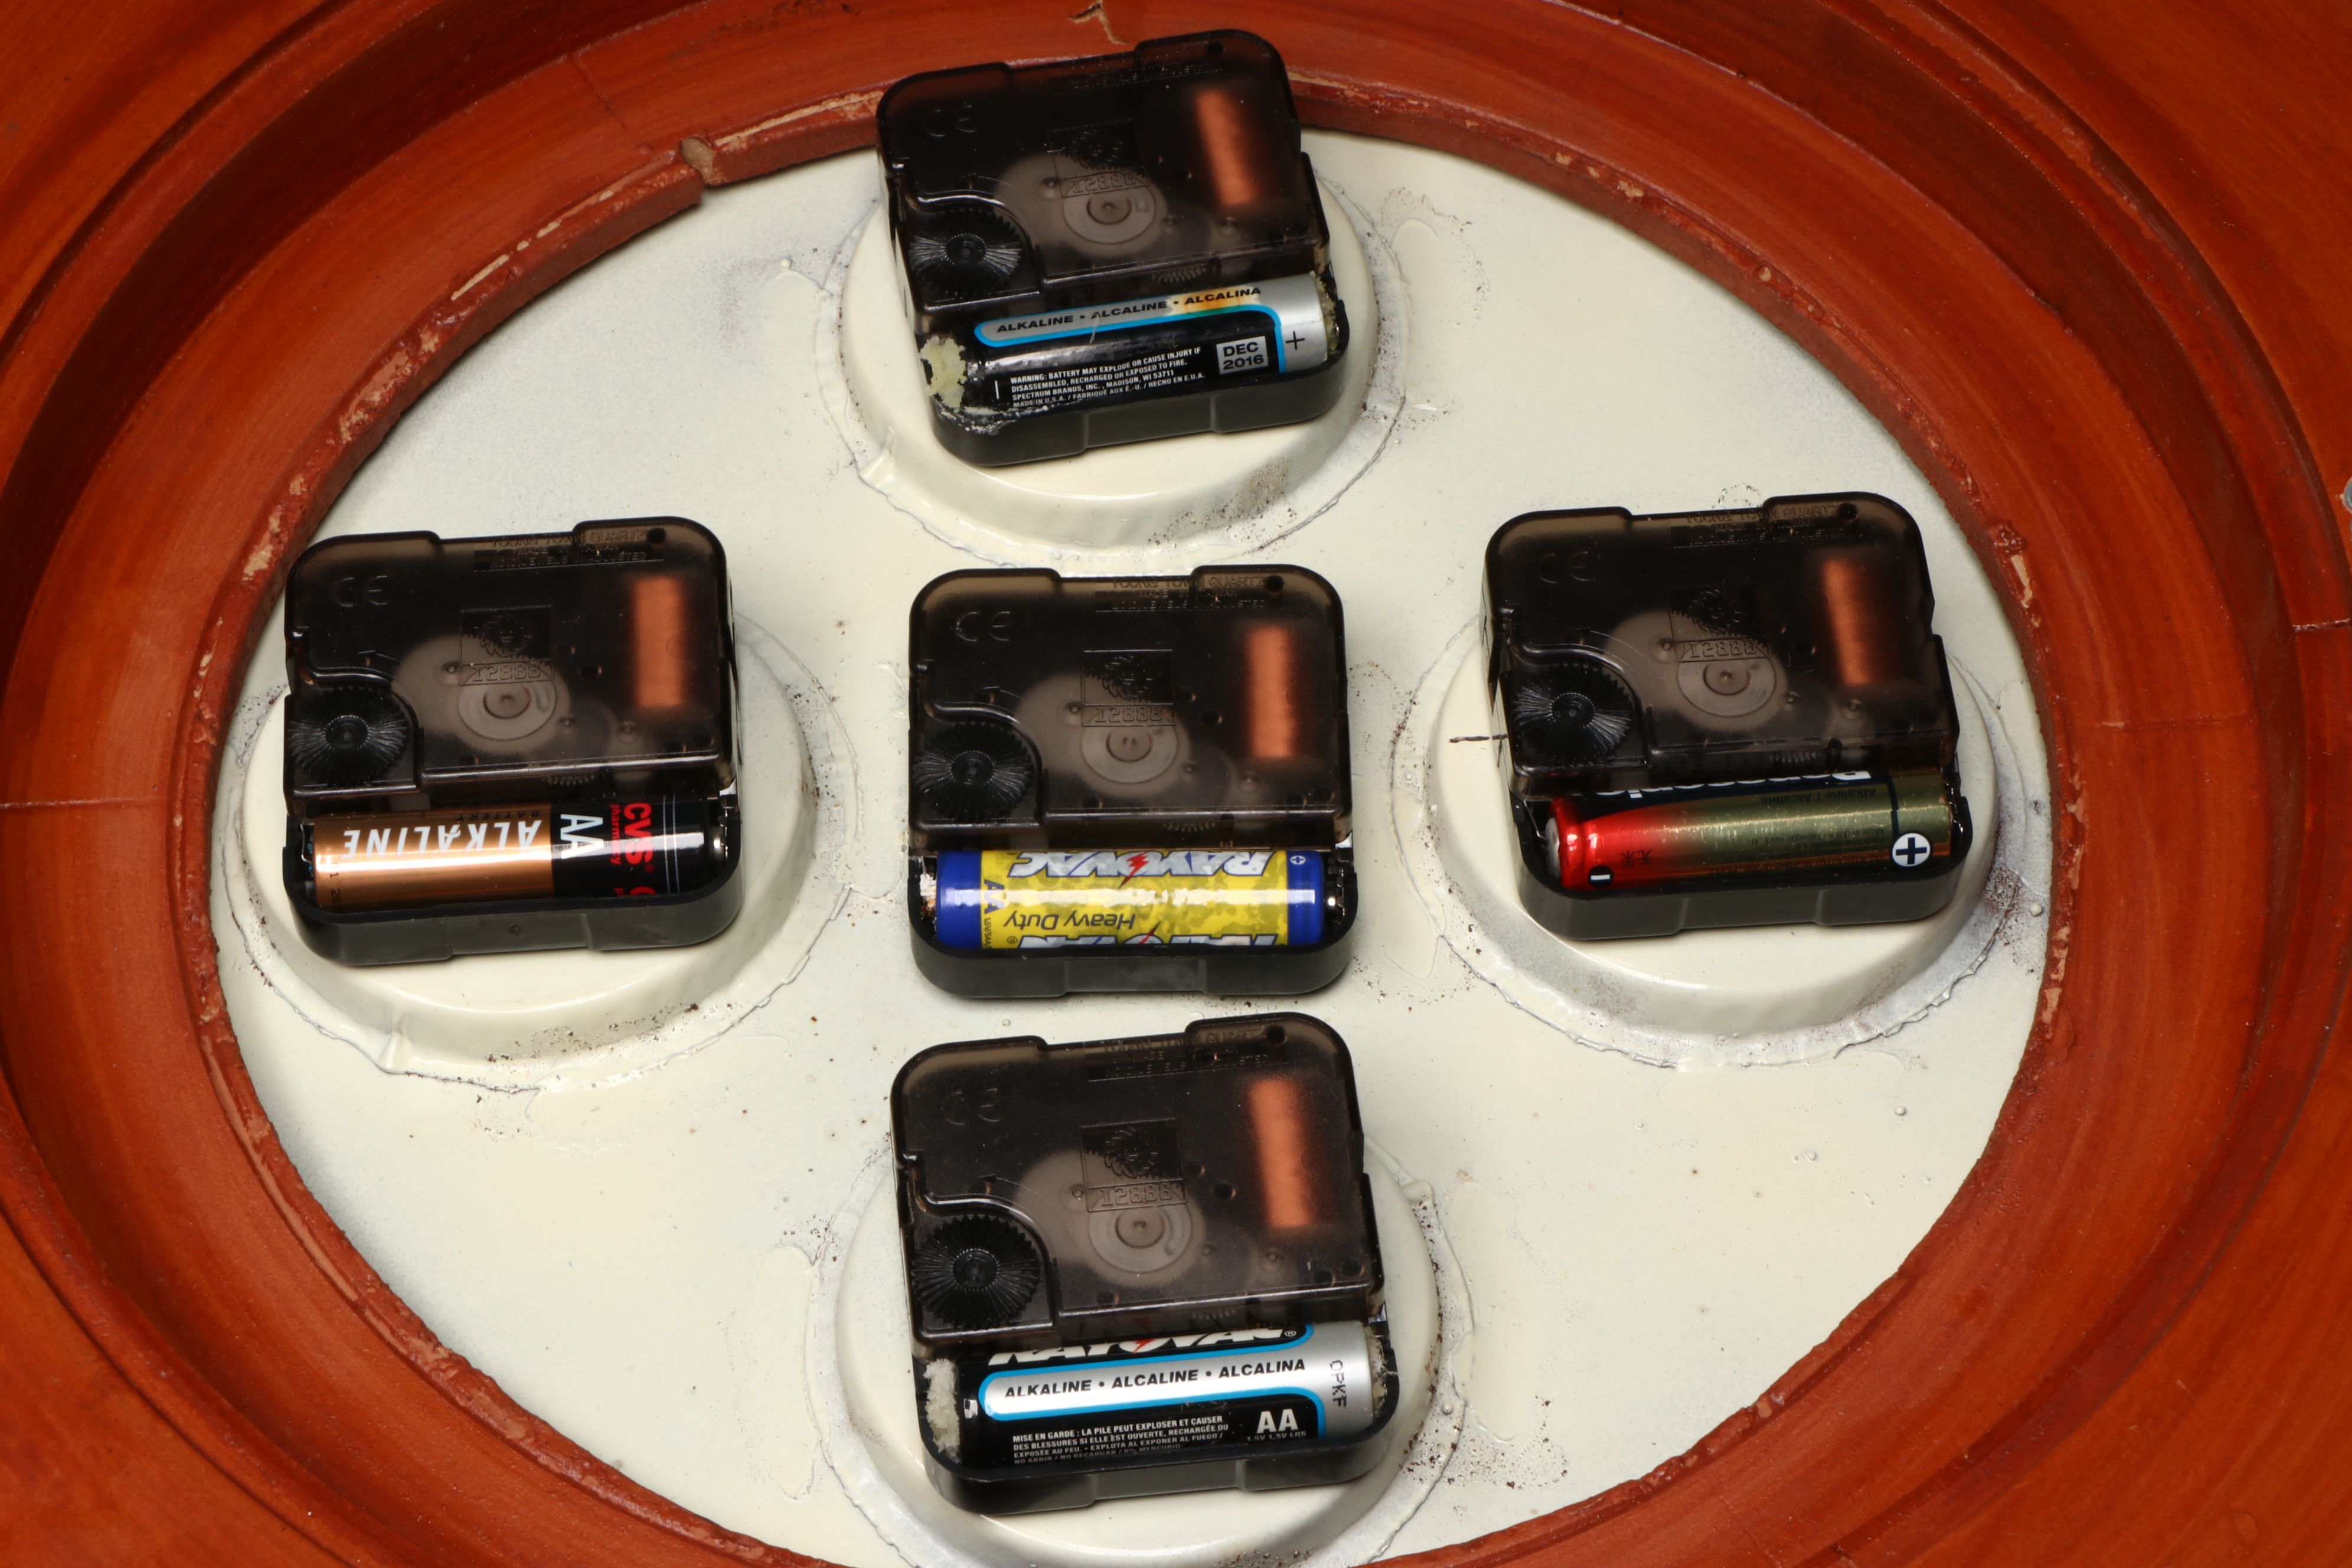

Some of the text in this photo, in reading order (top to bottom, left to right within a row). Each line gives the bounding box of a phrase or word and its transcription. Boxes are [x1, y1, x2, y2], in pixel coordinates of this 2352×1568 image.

[997, 288, 1261, 333] ALKALINE ALCALINE ALCALINA
[1223, 342, 1259, 357] DEC
[1223, 354, 1264, 370] 2016
[1010, 374, 1047, 384] WARNING:
[1048, 369, 1080, 380] BATTERY
[1100, 362, 1131, 373] EXPLODE
[1143, 354, 1166, 365] CAUSE
[1168, 348, 1192, 359] INJURY
[1011, 380, 1069, 393] DISASSEMBLED,
[1070, 373, 1112, 384] RECHARGED
[1125, 365, 1157, 377] EXPOSED
[1169, 359, 1187, 367] FIRE.
[1012, 389, 1050, 401] SPECTRUM
[1053, 385, 1084, 395] BRANDS,
[1106, 377, 1141, 388] MADISON,
[1153, 370, 1174, 379] 53711
[1013, 399, 1035, 408] MADE
[1045, 395, 1066, 404] U.S.A.
[1073, 387, 1107, 400] FABRIQUÉ
[1148, 378, 1172, 388] HECHO
[1184, 372, 1205, 381] E.U.A.
[590, 528, 648, 543] QUARTZ
[1208, 576, 1266, 587] QUARTZ
[472, 662, 541, 682] 12888
[1095, 707, 1162, 723] 12888
[1760, 793, 1812, 805] Alcaline
[1825, 788, 1877, 800] Alkaline
[456, 811, 540, 822] BATTERY
[340, 820, 542, 860] ALKALINE
[560, 814, 605, 860] AA
[623, 802, 655, 865] CVS
[1008, 850, 1276, 877] RAYOVAC
[984, 879, 1005, 914] AA
[1004, 910, 1136, 930] Heavy Duty
[1100, 1181, 1173, 1206] 12888
[1005, 1359, 1305, 1397] ALKALINE ALCALINE ALCALINA
[1012, 1434, 1033, 1443] MISE
[1048, 1430, 1076, 1439] GARDE
[1094, 1426, 1112, 1435] PILE
[1113, 1424, 1133, 1433] PEUT
[1136, 1419, 1177, 1430] EXPLOSER
[1191, 1415, 1223, 1425] CAUSER
[1256, 1409, 1299, 1433] AA
[1014, 1449, 1050, 1458] EXPOSÉE
[1090, 1441, 1126, 1451] EXPLOTA
[1140, 1436, 1177, 1446] EXPONER
[1191, 1433, 1217, 1441] FUEGO
[1031, 1439, 1077, 1449] BLESSURES
[1089, 1435, 1109, 1444] ELLE
[1127, 1430, 1167, 1440] OUVERTE,
[1168, 1425, 1216, 1436] RECHARGÉE
[1073, 1449, 1116, 1458] RECARGAR
